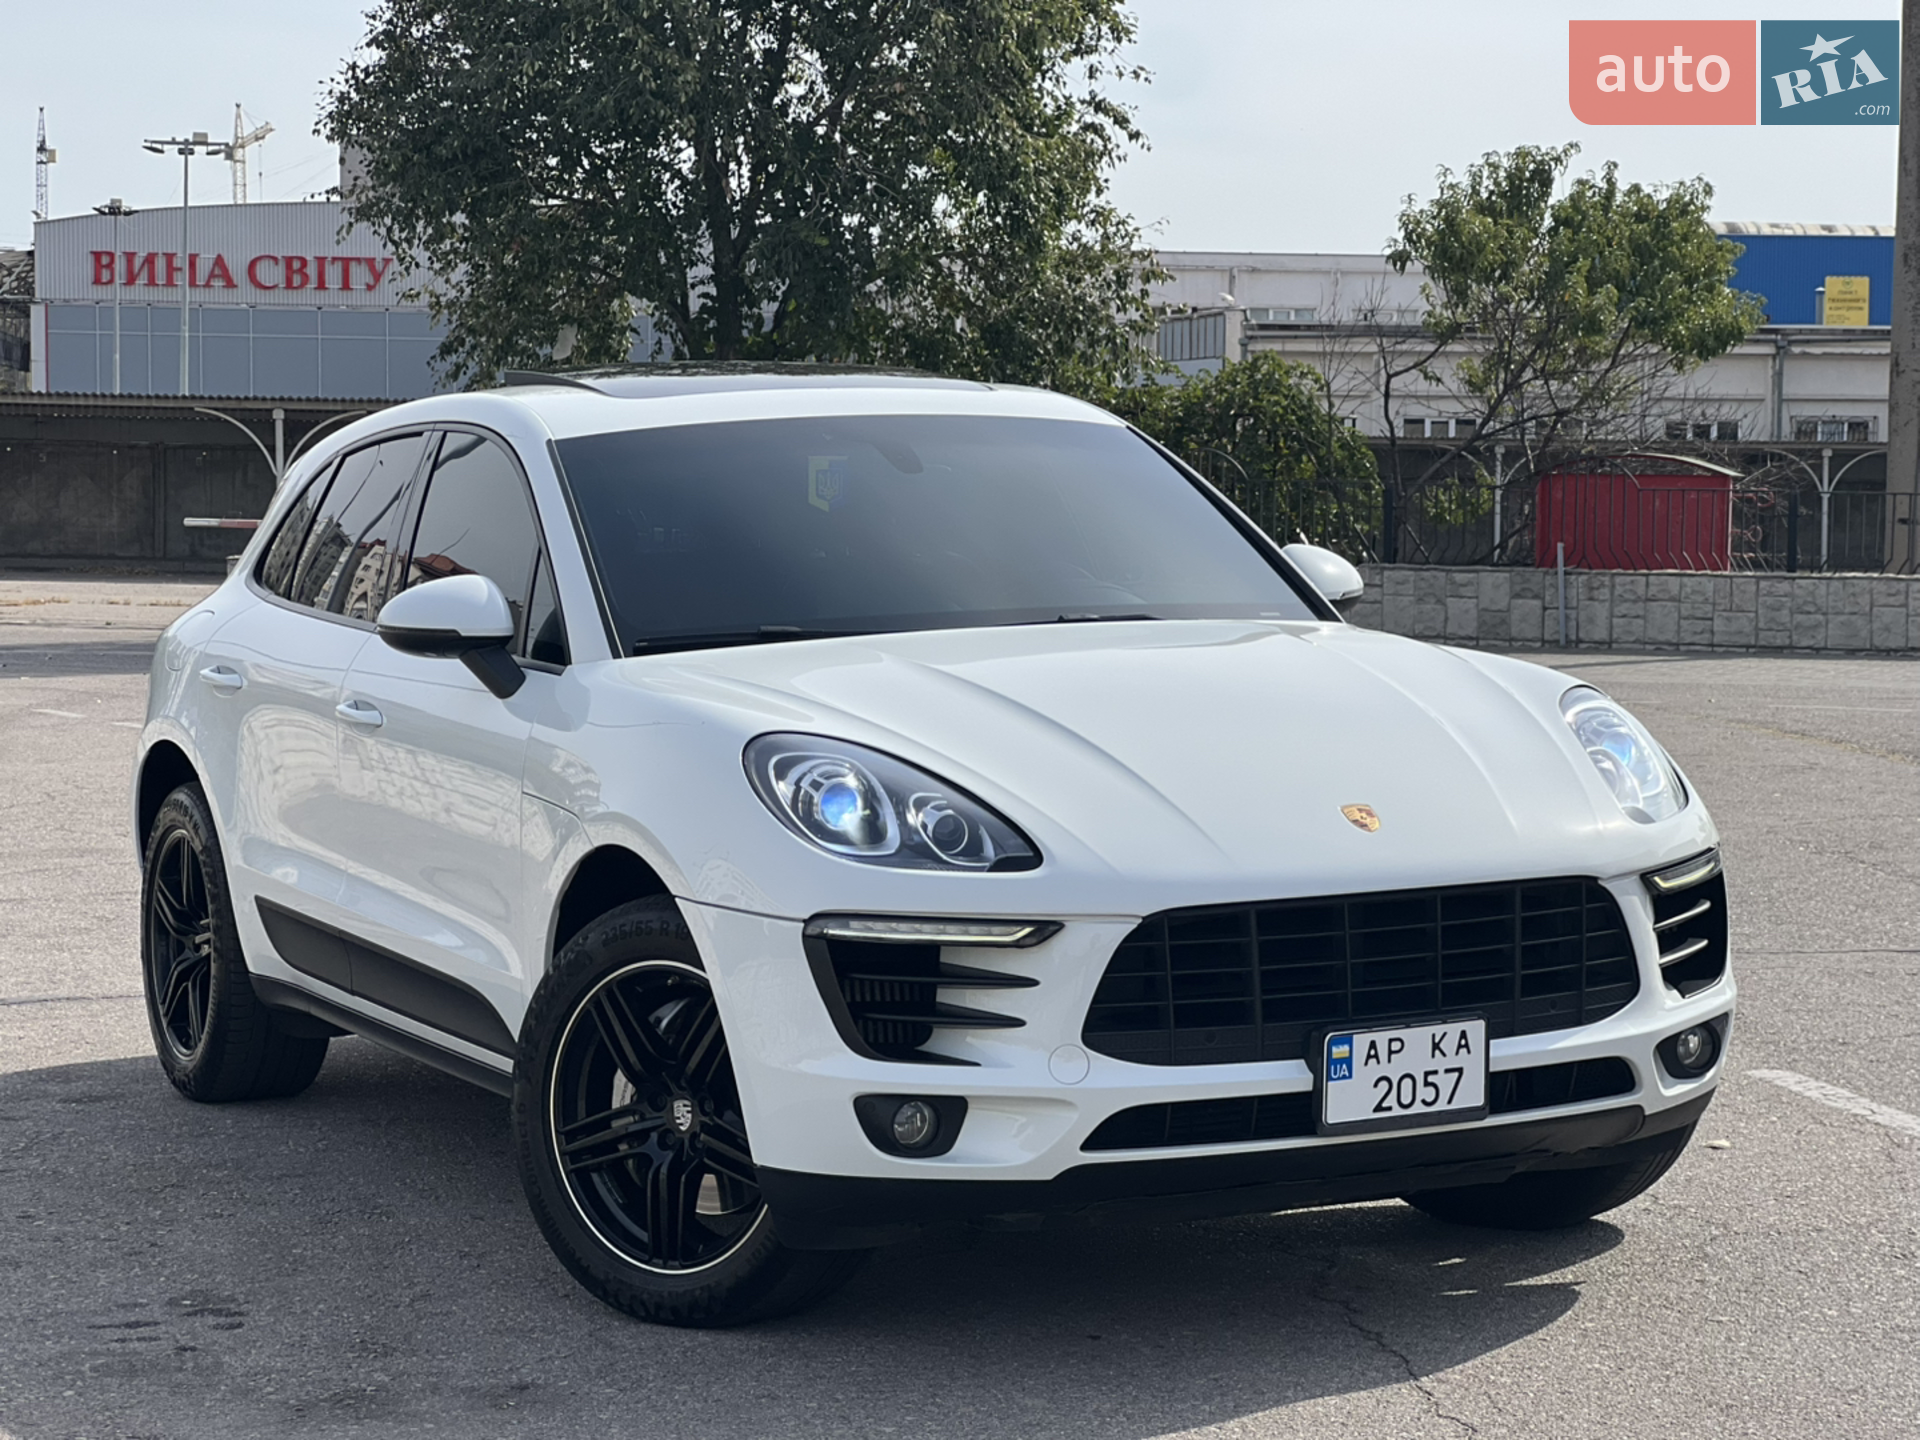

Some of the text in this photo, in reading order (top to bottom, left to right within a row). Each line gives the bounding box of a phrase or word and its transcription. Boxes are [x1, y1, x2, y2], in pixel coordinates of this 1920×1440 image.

[90, 250, 394, 292] ВИНА СВІТУ
[1363, 1029, 1471, 1067] AP KA
[1330, 1064, 1350, 1079] UA
[1372, 1066, 1465, 1113] 2057
